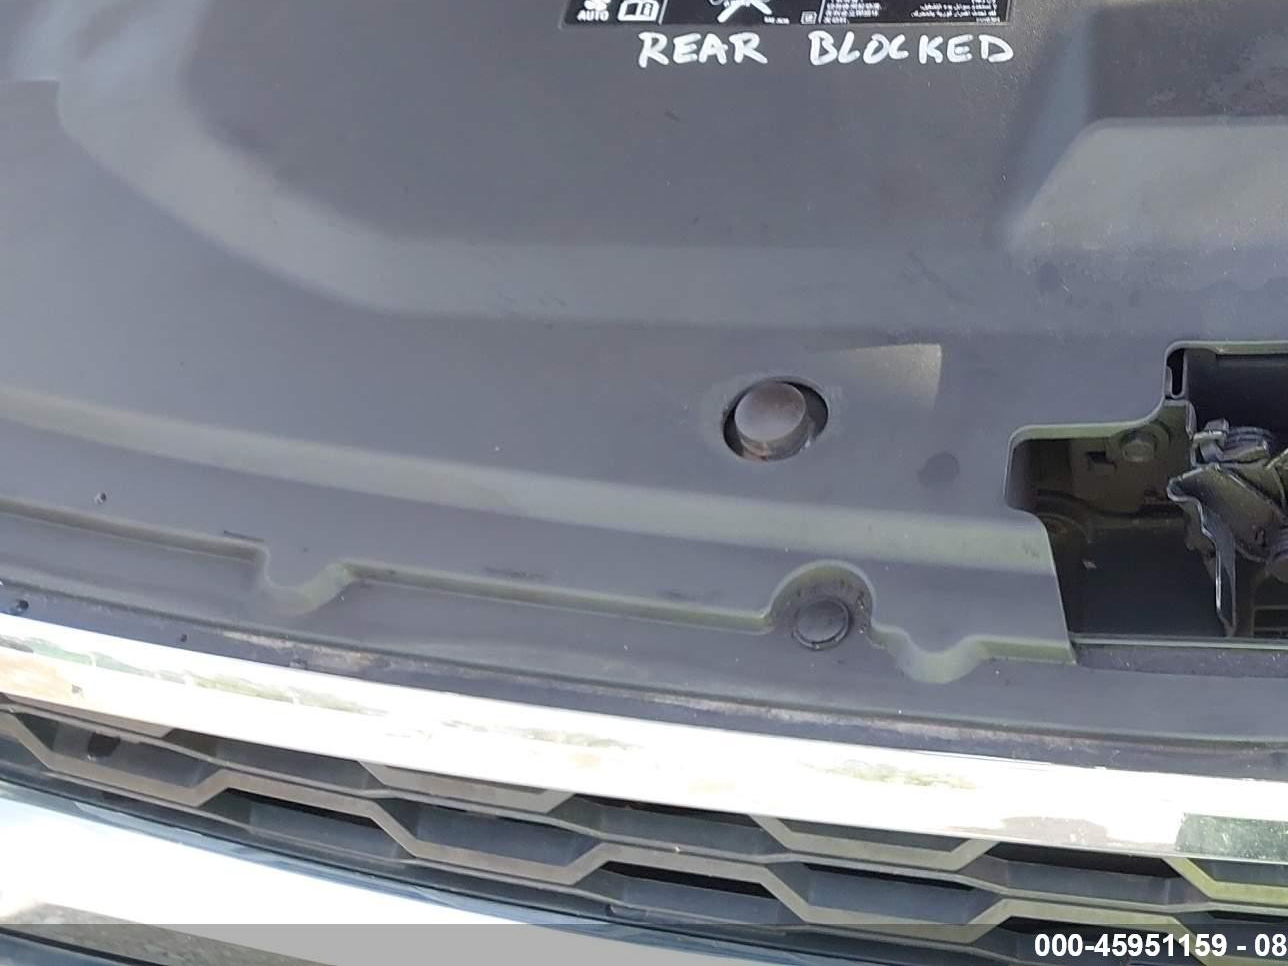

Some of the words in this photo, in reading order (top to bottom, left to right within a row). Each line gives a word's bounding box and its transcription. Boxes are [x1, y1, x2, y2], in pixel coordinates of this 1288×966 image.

[577, 10, 609, 22] AUTO
[638, 31, 768, 68] REAR
[808, 30, 1014, 66] BLOCKED
